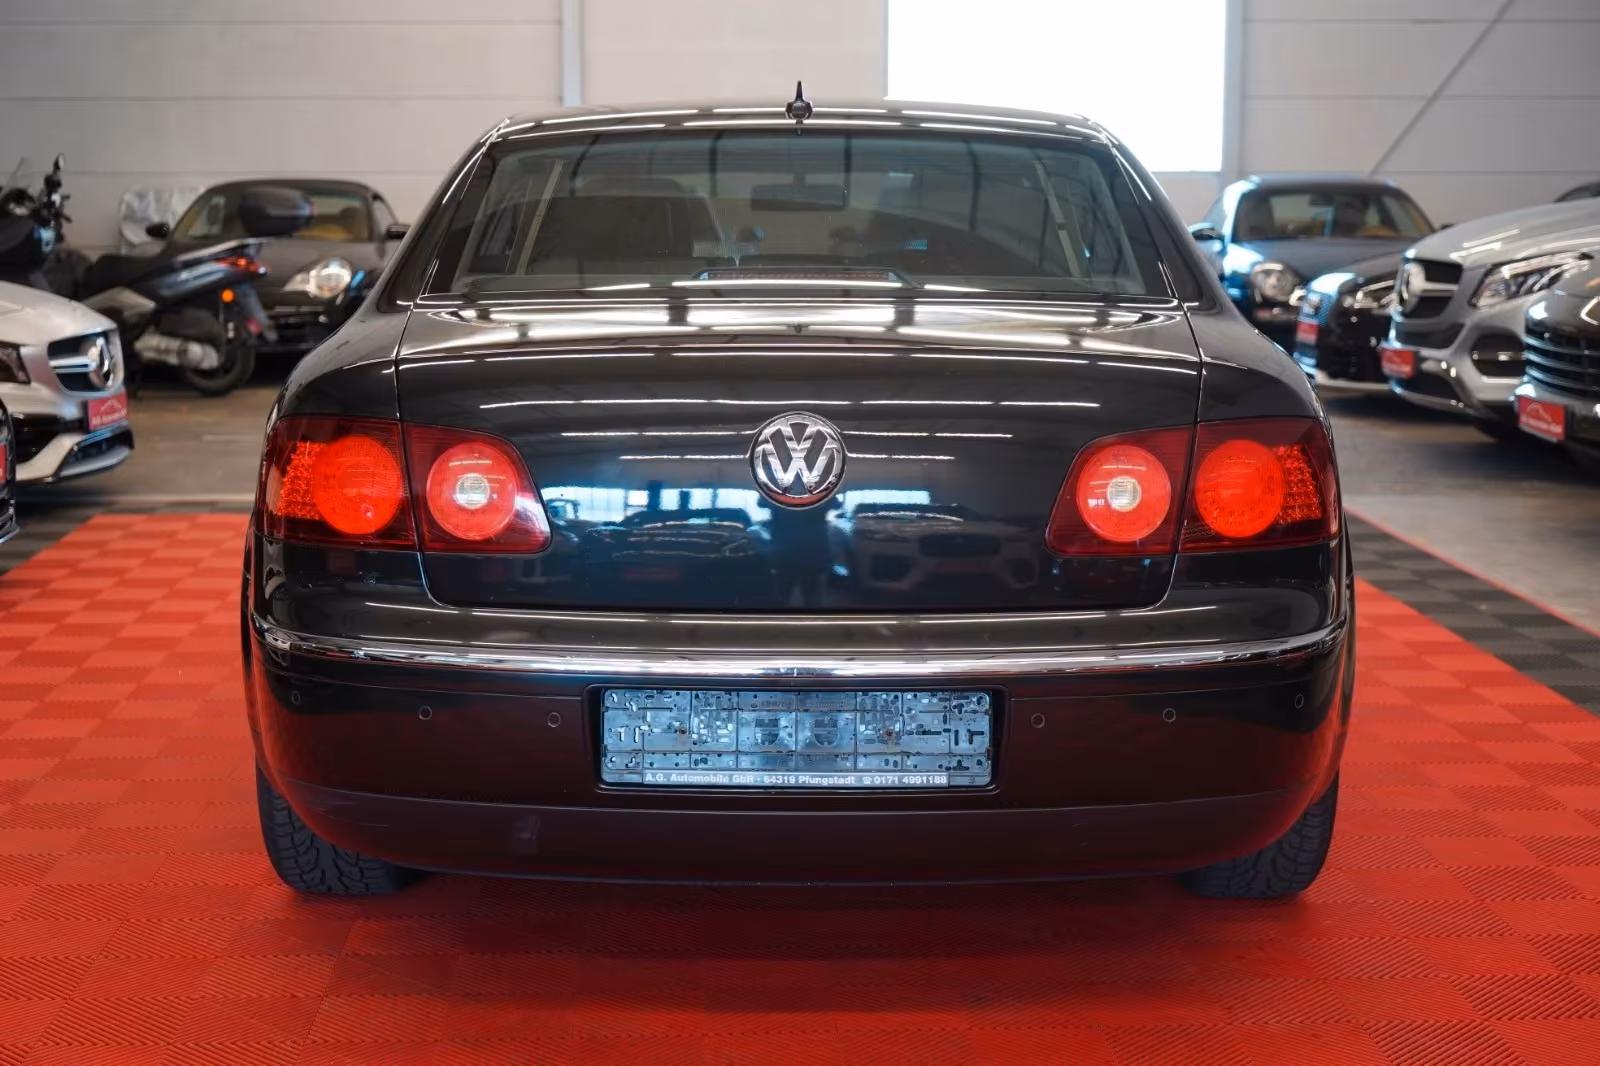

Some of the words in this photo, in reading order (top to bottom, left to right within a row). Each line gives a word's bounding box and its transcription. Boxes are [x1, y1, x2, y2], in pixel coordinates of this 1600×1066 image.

[754, 414, 842, 498] VW
[645, 773, 667, 782] A.G.
[670, 773, 729, 783] Automobile
[732, 774, 754, 783] GbR
[763, 775, 795, 784] 64319
[798, 775, 855, 785] Pfungstadt
[873, 776, 899, 784] 0171
[902, 775, 947, 784] 4991188
